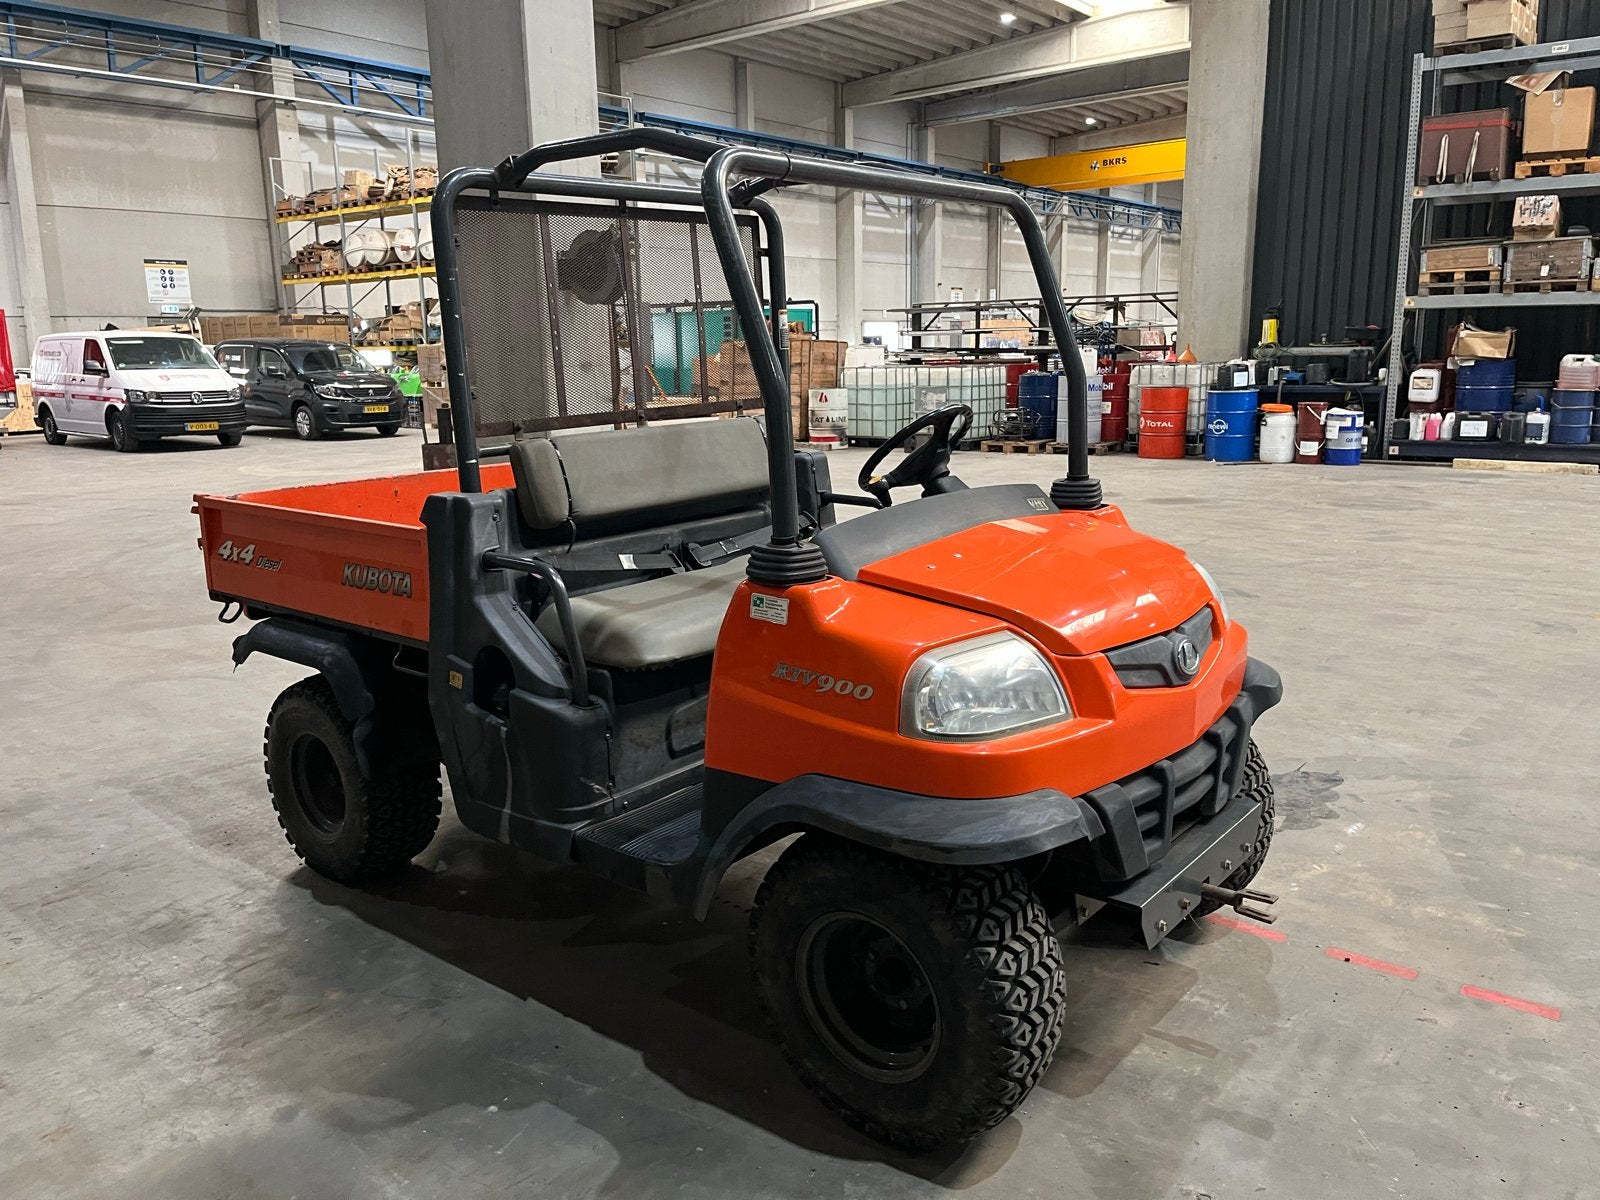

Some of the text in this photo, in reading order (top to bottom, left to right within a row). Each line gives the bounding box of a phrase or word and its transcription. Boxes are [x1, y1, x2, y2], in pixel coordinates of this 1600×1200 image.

[1102, 156, 1127, 167] BKRS
[1145, 420, 1174, 428] TOTAL
[217, 540, 283, 572] 4x4 Diesel
[341, 562, 413, 598] KUBOTA
[771, 661, 874, 700] RTV900
